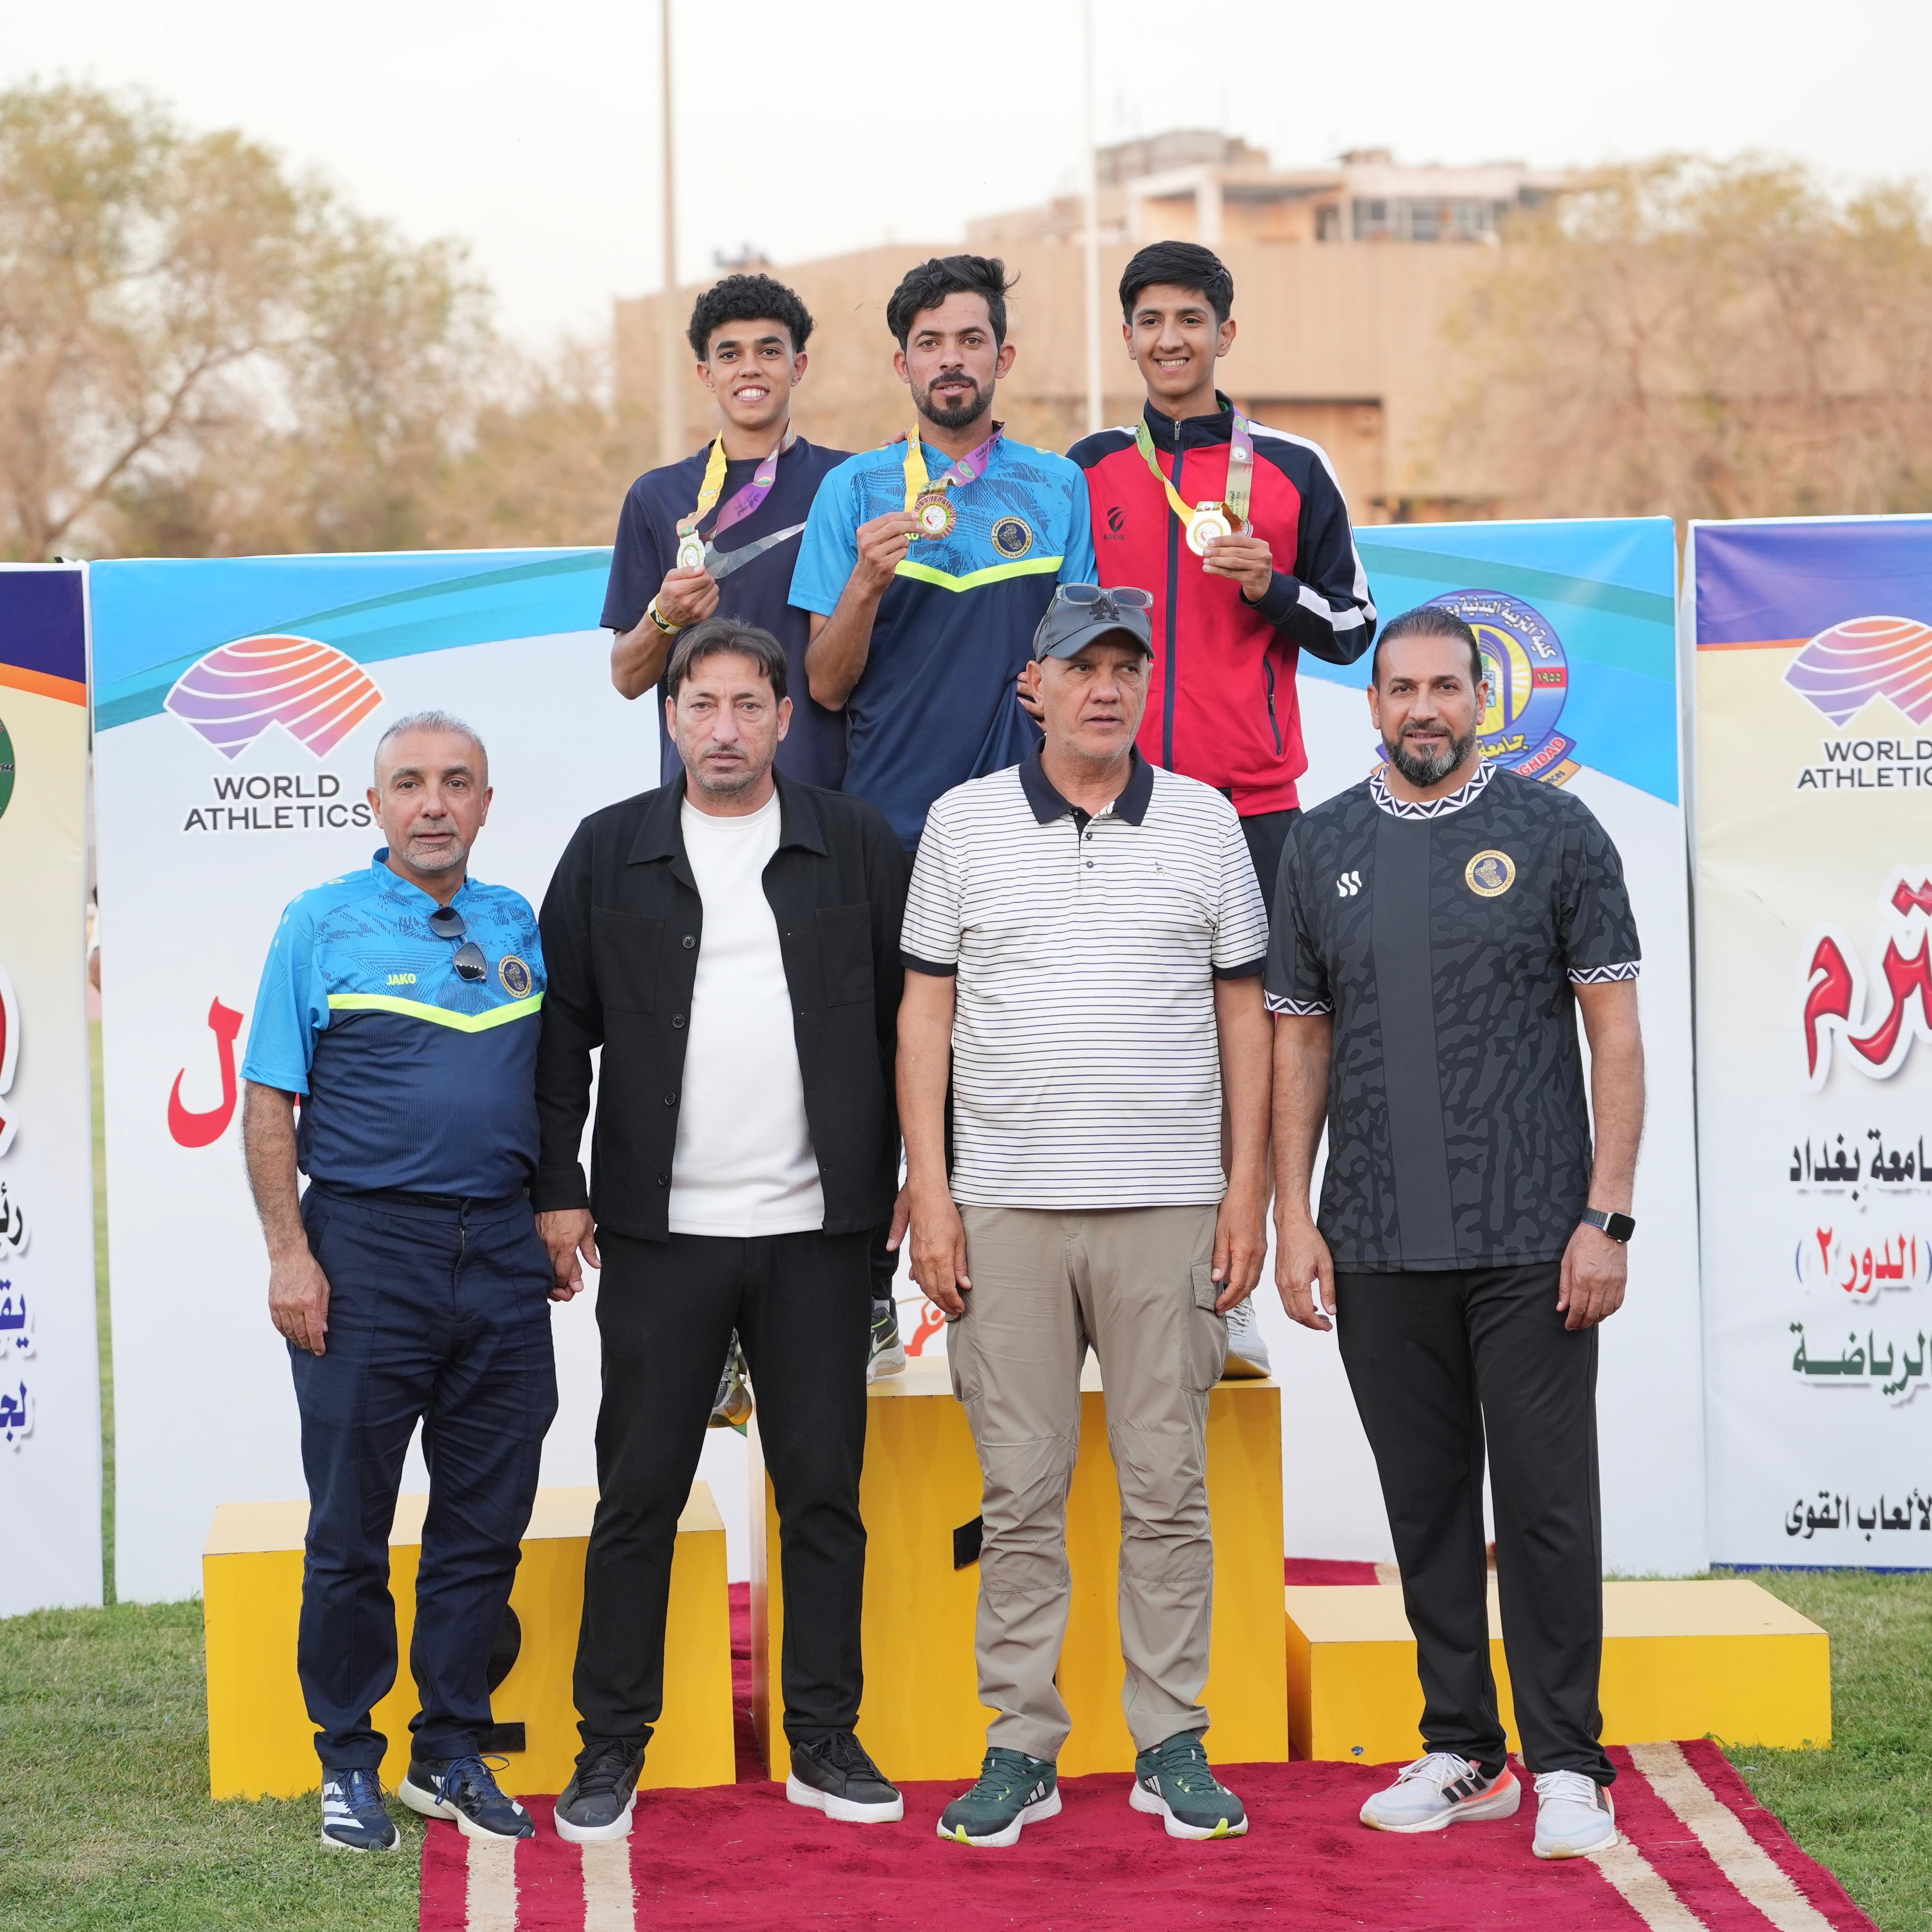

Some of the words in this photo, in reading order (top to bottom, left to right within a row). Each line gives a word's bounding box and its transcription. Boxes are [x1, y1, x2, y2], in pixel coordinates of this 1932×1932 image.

[1512, 737, 1567, 776] GHDAD
[1824, 740, 1932, 762] WORLD
[213, 774, 340, 800] WORLD
[183, 804, 371, 831] ATHLETICS
[386, 973, 416, 985] JAKO
[1789, 1132, 1860, 1202] بغداد
[1867, 1128, 1932, 1182] امعة
[1785, 1490, 1850, 1539] القوى
